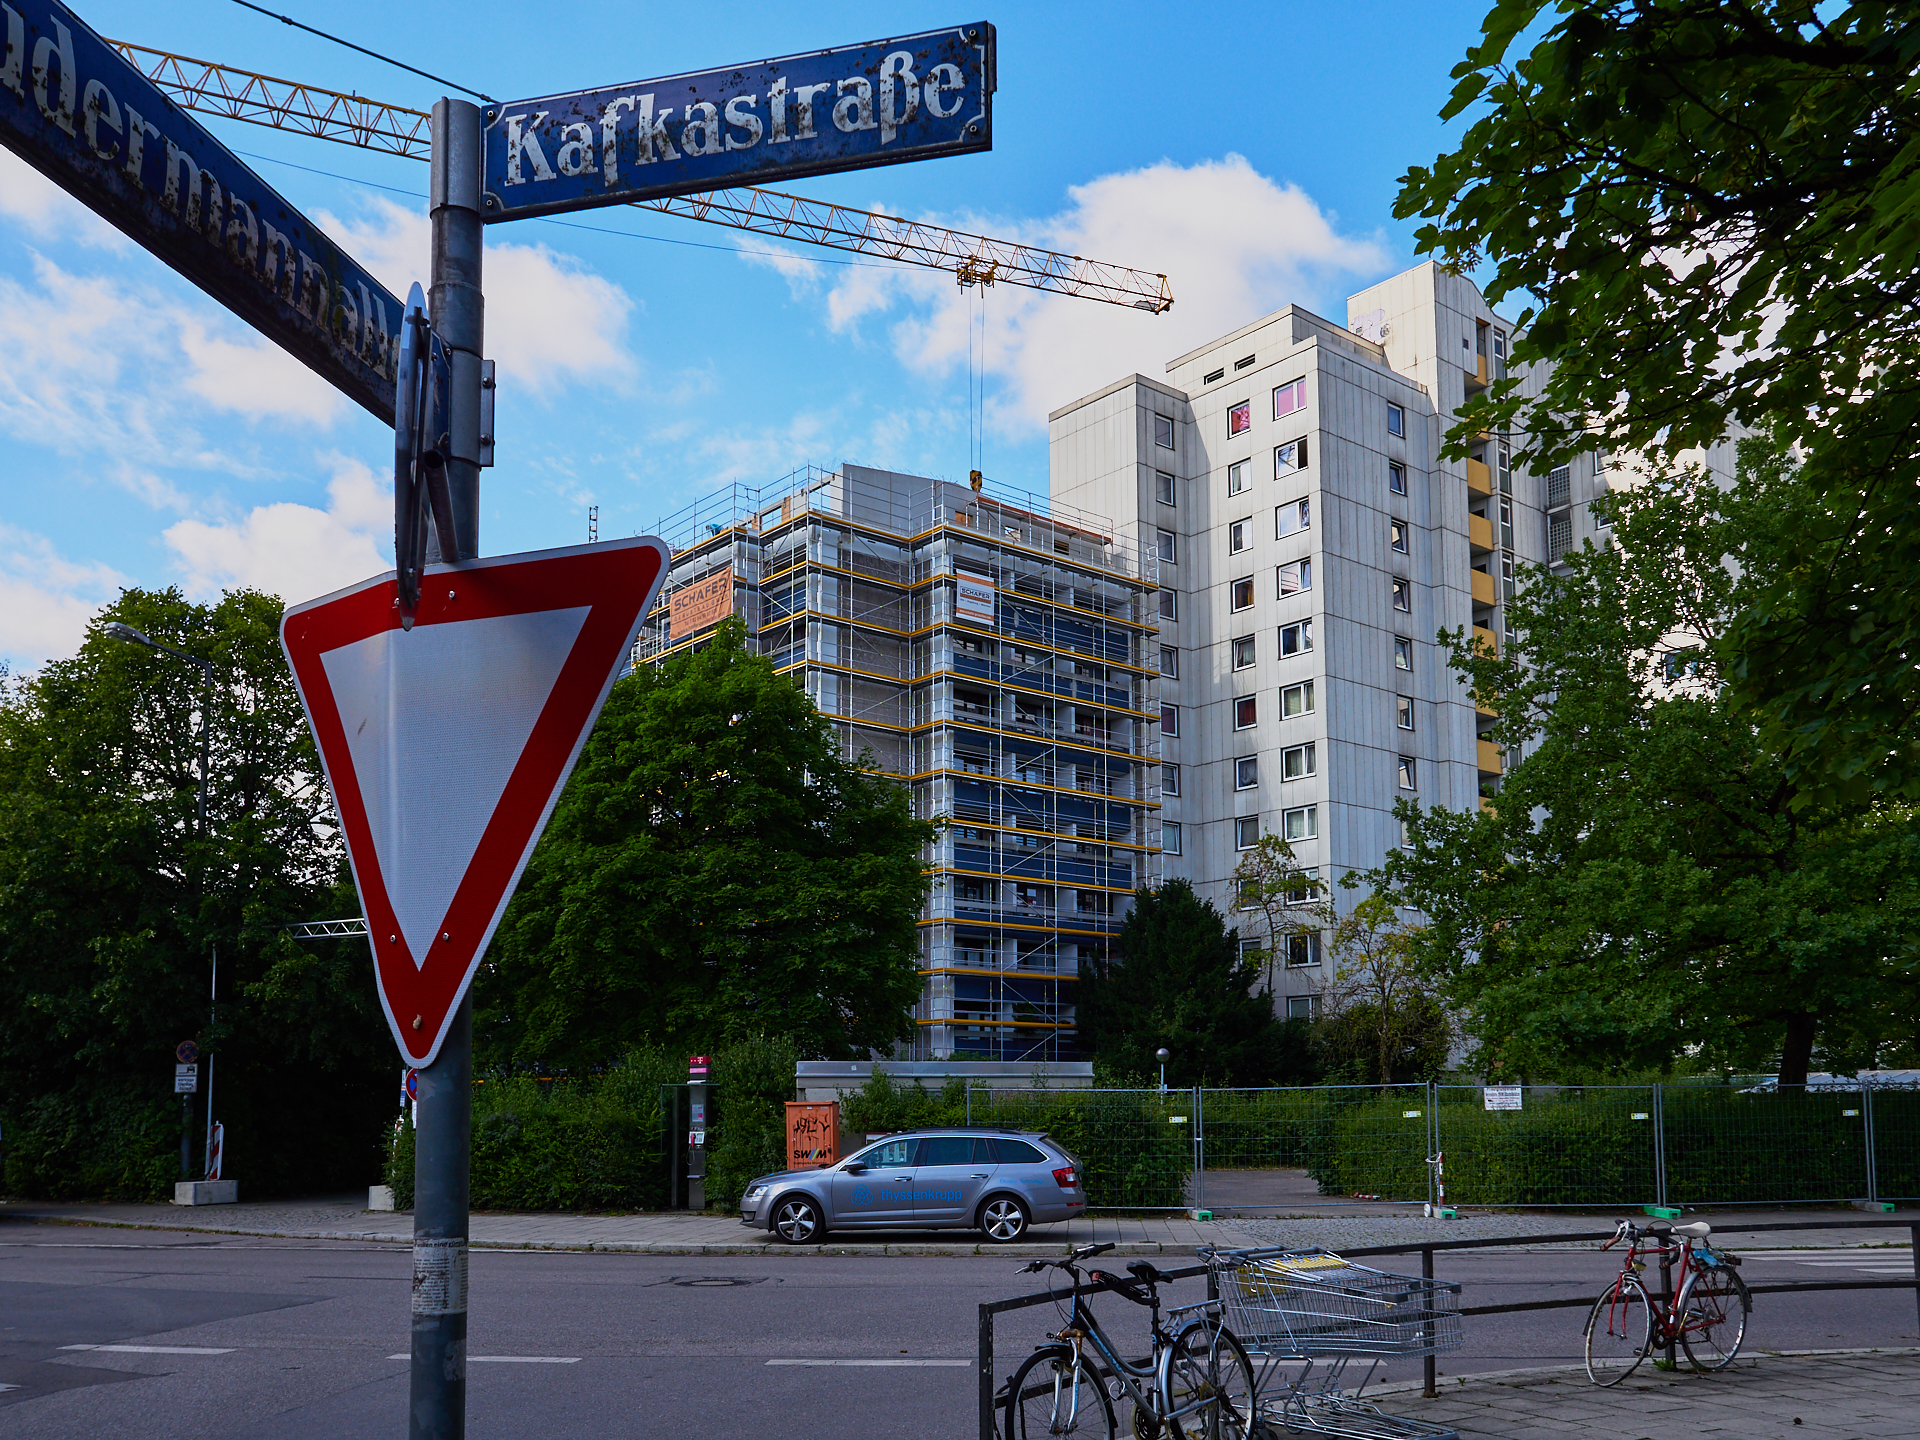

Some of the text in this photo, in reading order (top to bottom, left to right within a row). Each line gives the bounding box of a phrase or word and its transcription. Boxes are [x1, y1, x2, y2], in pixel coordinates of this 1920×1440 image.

[503, 50, 965, 187] Kafkastraße
[674, 577, 727, 612] SCHÄFER
[880, 1188, 962, 1203] thyssenkrupp
